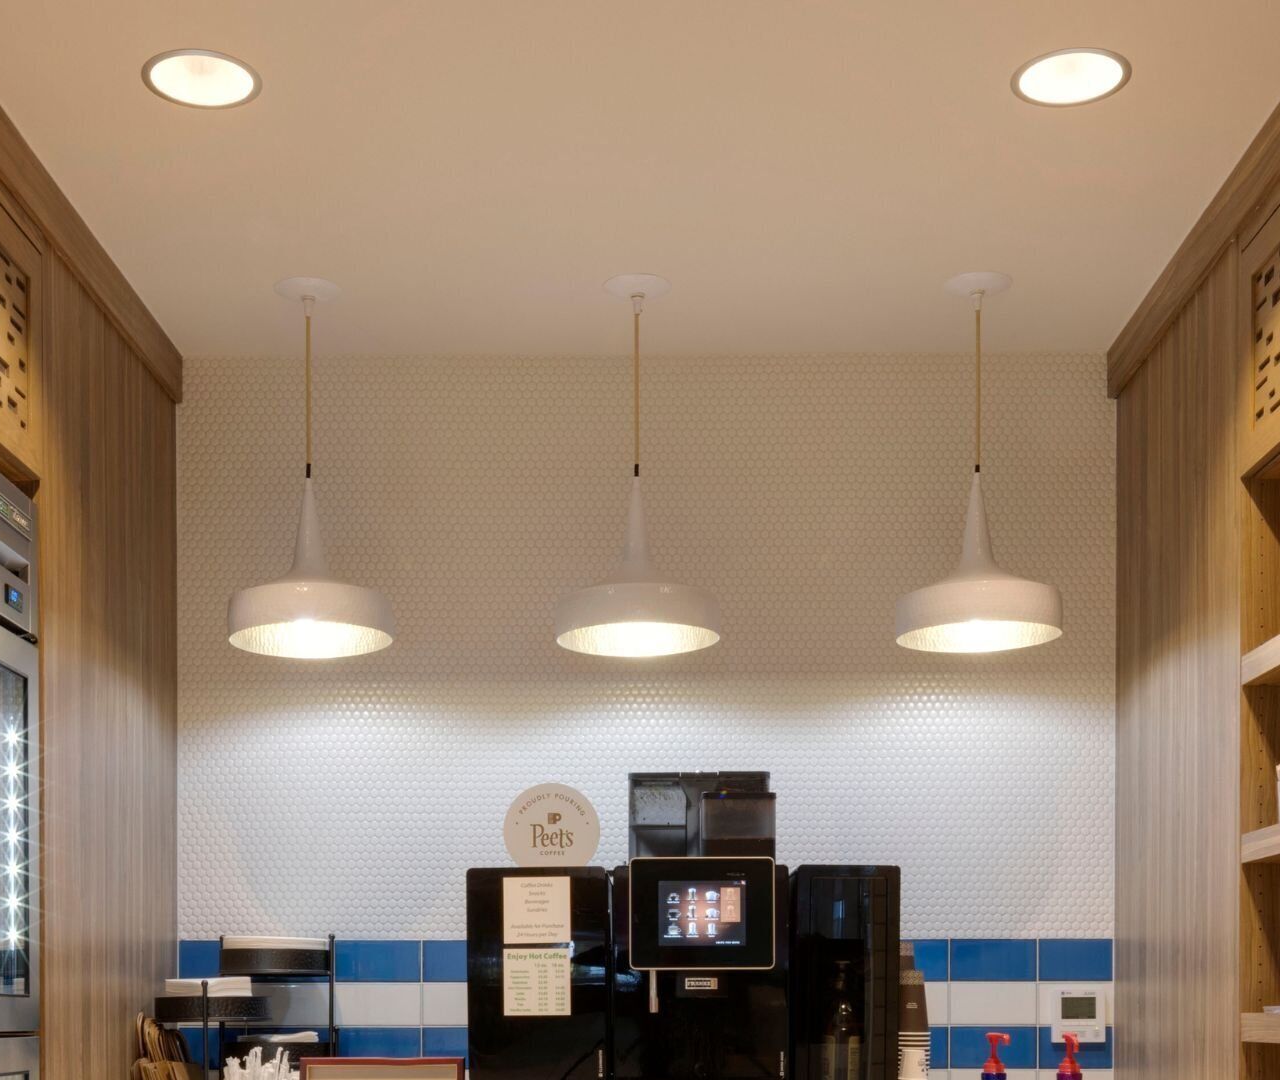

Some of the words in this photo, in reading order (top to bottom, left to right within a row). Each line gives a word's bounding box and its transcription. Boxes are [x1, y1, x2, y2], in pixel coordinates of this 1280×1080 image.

[518, 792, 551, 815] PROUDLY
[554, 792, 586, 817] POURING
[529, 823, 574, 849] Peet's
[507, 952, 527, 962] Enjoy
[528, 951, 543, 960] Hot
[544, 951, 567, 960] Coffee
